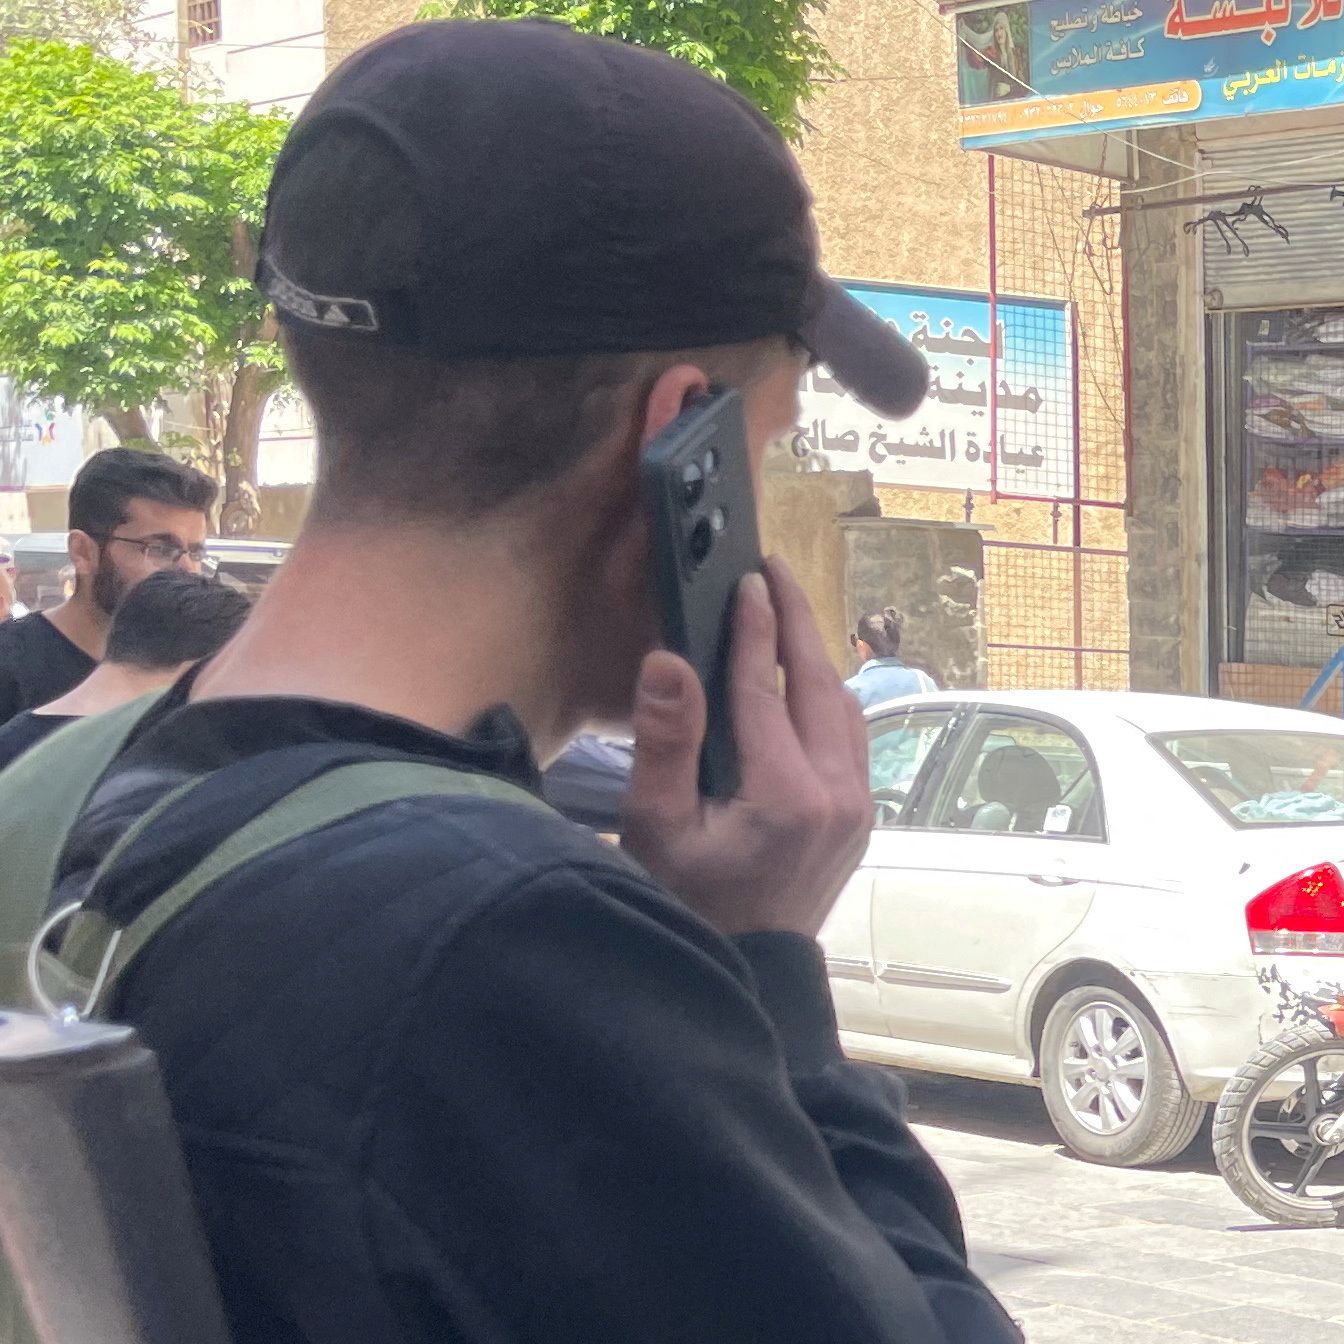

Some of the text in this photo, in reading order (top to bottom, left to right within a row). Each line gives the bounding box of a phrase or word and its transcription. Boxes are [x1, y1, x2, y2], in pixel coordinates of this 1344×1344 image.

[1101, 1, 1144, 28] خياطة
[1050, 37, 1145, 75] كافة الملابس
[1162, 87, 1190, 105] هاتف
[1222, 58, 1288, 101] العربي
[911, 311, 1004, 366] لجنة
[927, 365, 1044, 417] مدينة
[791, 418, 1045, 474] عيادة الشيخ صالح
